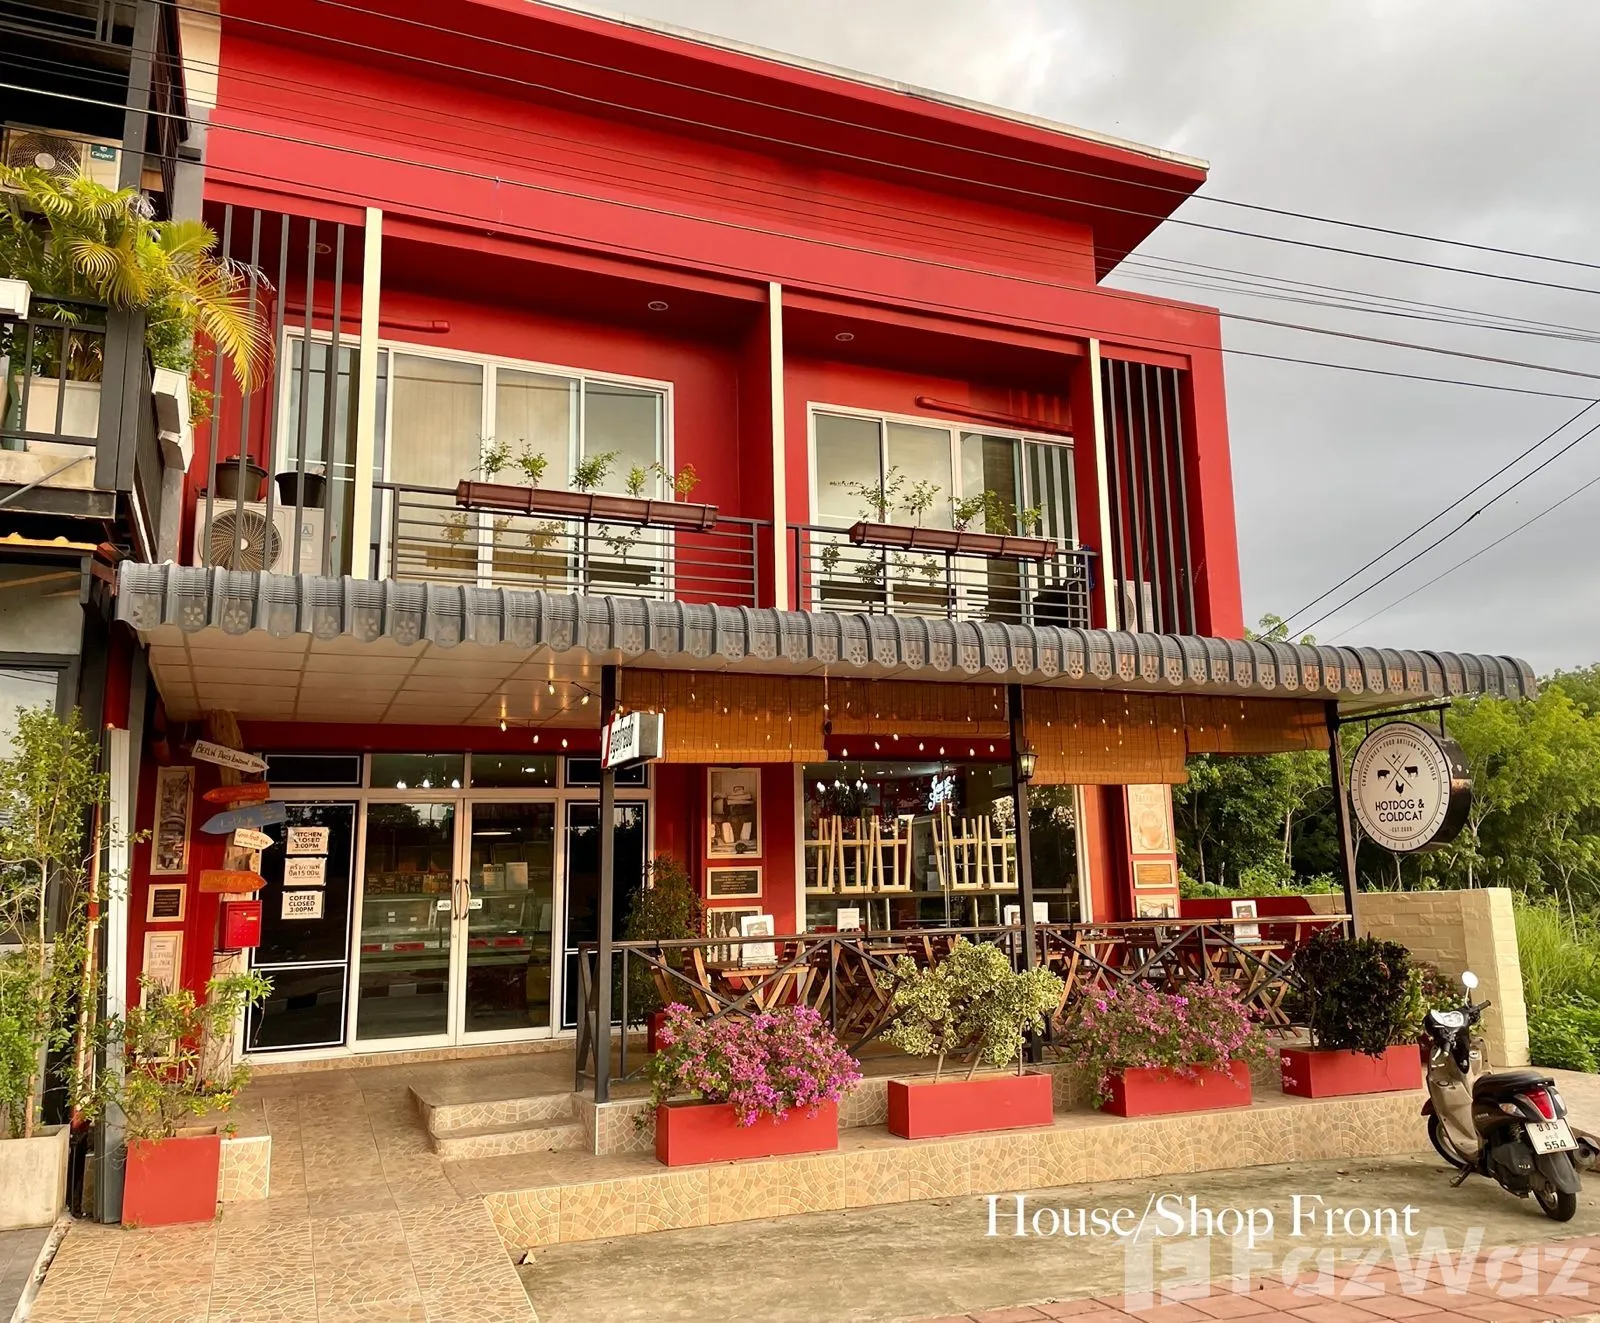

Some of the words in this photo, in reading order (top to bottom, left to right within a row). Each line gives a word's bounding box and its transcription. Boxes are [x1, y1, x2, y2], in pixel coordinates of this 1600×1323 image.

[1375, 799, 1415, 811] HOTDOG
[1418, 798, 1425, 809] &
[1379, 810, 1422, 822] COLDCAT
[1543, 1139, 1567, 1150] 554
